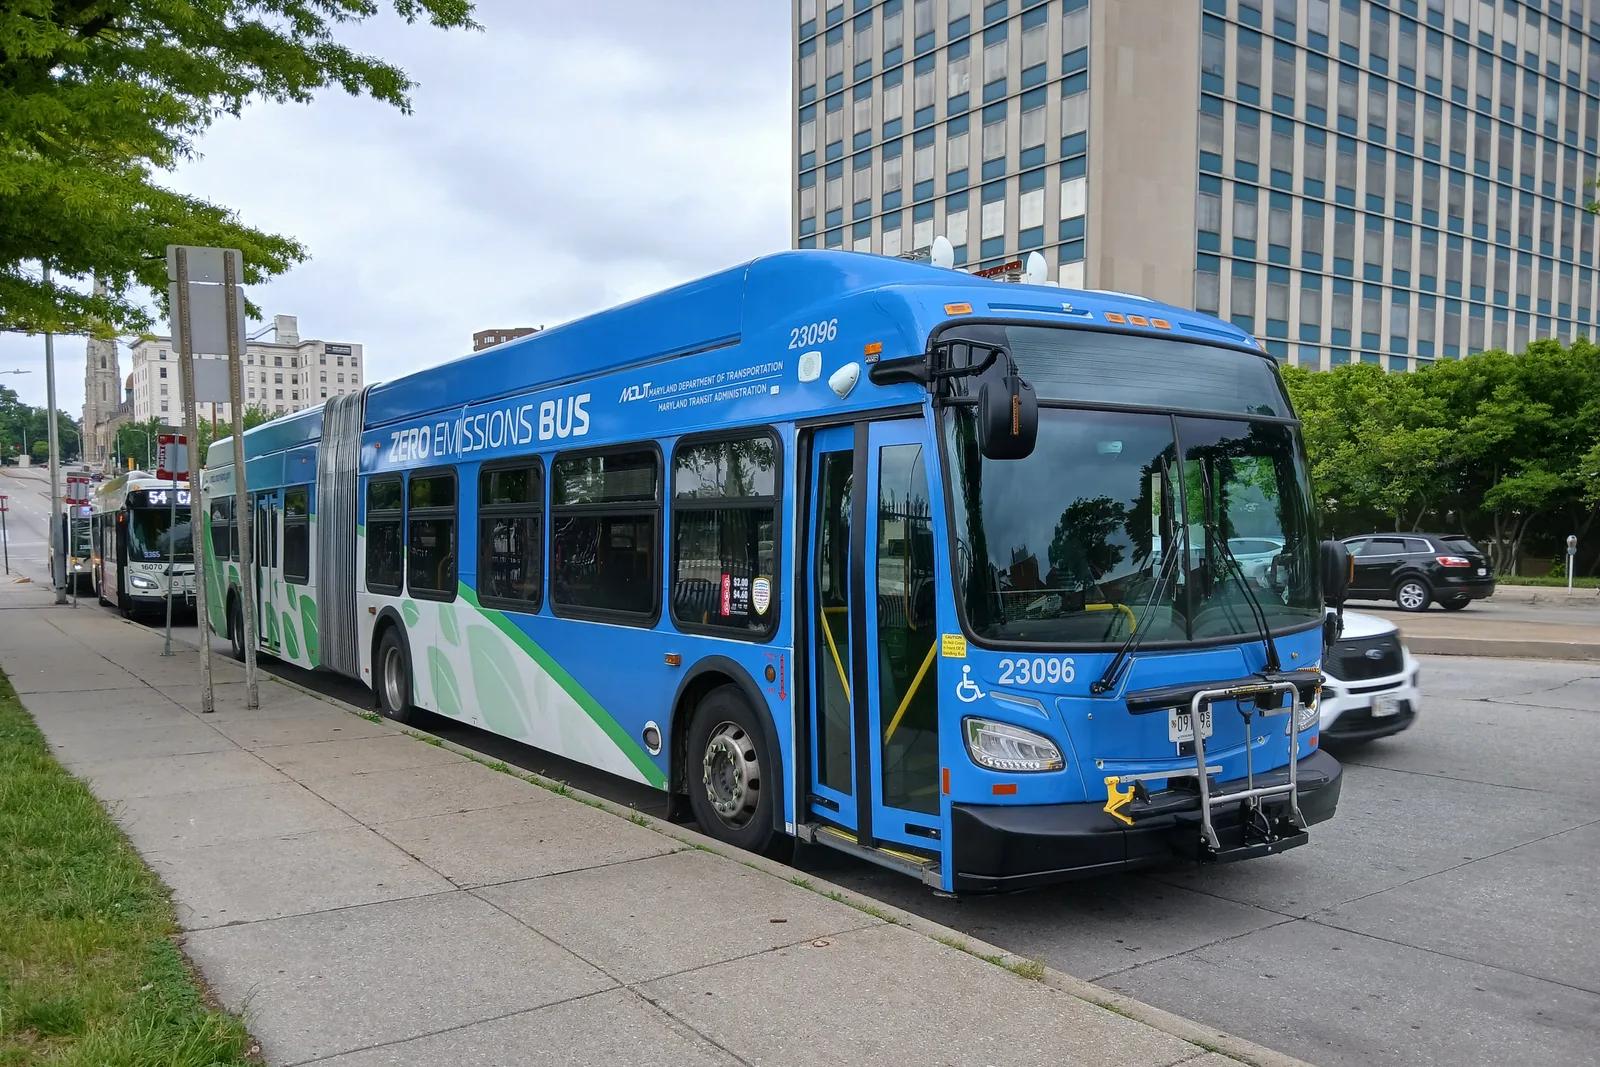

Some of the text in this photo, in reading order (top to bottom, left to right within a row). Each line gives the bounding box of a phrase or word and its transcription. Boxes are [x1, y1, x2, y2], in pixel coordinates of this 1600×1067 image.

[788, 318, 838, 349] 23096
[649, 360, 784, 397] MARYLAND DEPARTMENT OF TRANSPORTATION
[658, 384, 767, 413] MARYLAND TRANSIT ADMINISTRATION
[389, 393, 591, 463] ZERO EMISSIONS BUS
[148, 490, 167, 504] 54
[998, 657, 1075, 684] 23096
